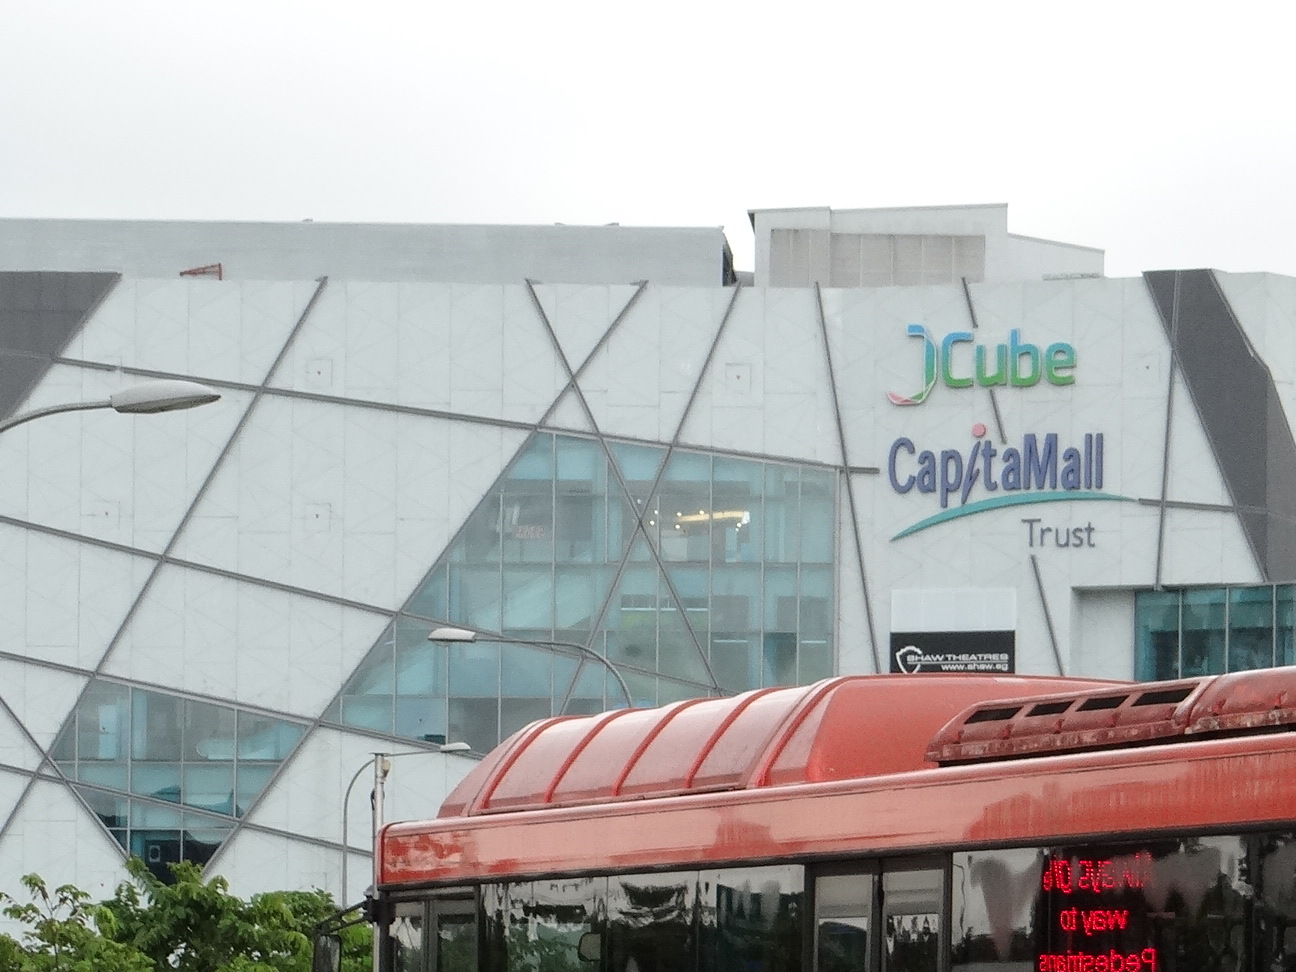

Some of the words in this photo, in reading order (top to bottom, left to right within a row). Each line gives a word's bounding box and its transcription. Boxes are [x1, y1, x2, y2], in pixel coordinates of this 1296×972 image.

[887, 323, 1077, 405] JCube
[888, 423, 1104, 508] CapitaMall
[1021, 518, 1096, 548] Trust
[906, 654, 944, 662] SHAW
[945, 653, 1009, 661] THEATRES
